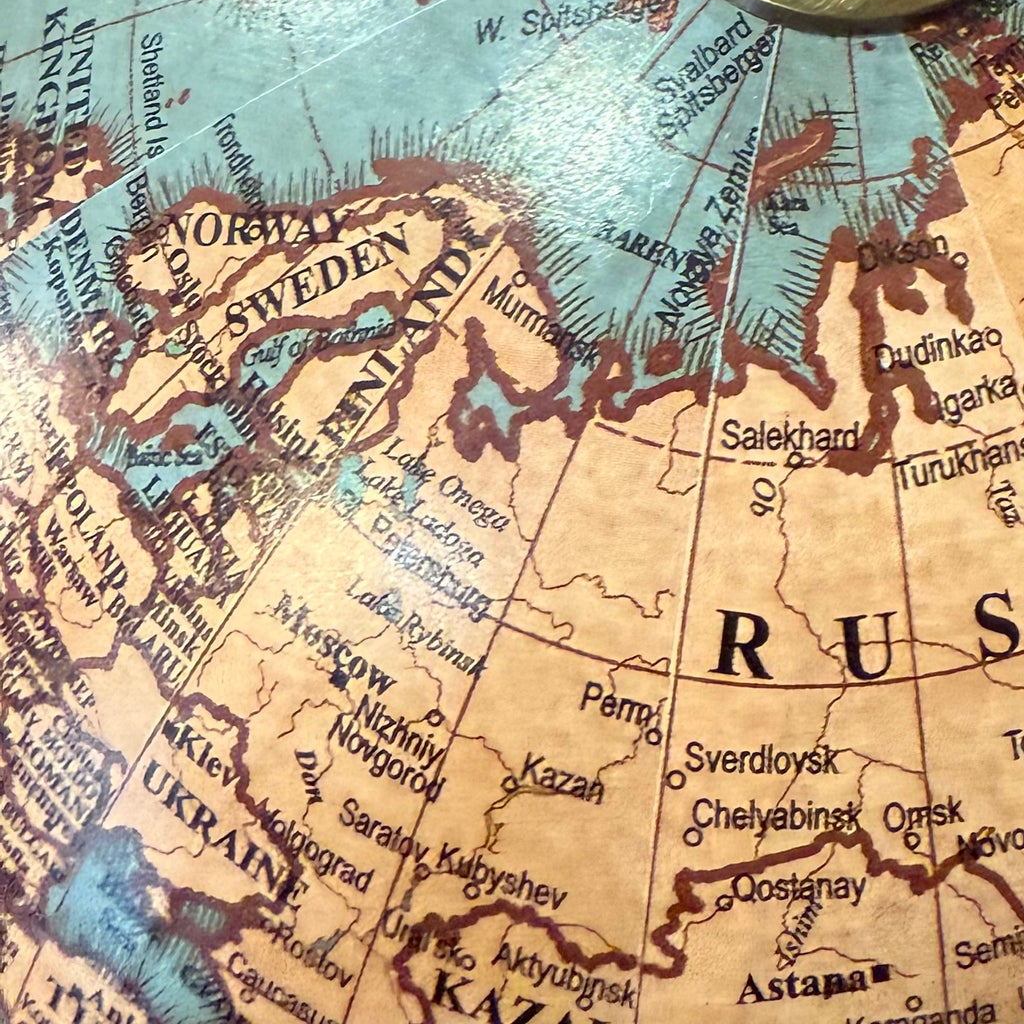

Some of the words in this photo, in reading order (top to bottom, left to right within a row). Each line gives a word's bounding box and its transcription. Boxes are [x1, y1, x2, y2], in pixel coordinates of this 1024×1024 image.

[167, 247, 202, 310] Oslo
[225, 222, 410, 338] SWEDEN
[873, 325, 986, 374] Dudinka
[721, 418, 861, 453] Salekhard
[356, 456, 406, 504] Lake
[381, 438, 438, 484] Lake
[438, 474, 513, 534] Onega
[749, 476, 778, 518] Ob
[990, 478, 1022, 529] Taz
[327, 711, 448, 804] Novgorod
[354, 693, 446, 771] Nizhniy
[685, 741, 841, 775] Sverdlovsk
[295, 747, 325, 805] Don
[521, 750, 606, 806] Kazan
[142, 758, 310, 908] UKRAINE
[339, 797, 431, 865] Saratov
[692, 796, 863, 837] Chelyabinsk
[883, 794, 965, 833] Omsk
[256, 795, 377, 895] Volgograd
[731, 872, 868, 907] Qostanay
[491, 942, 637, 1011] Aktyubinsk
[737, 968, 870, 1006] Astana
